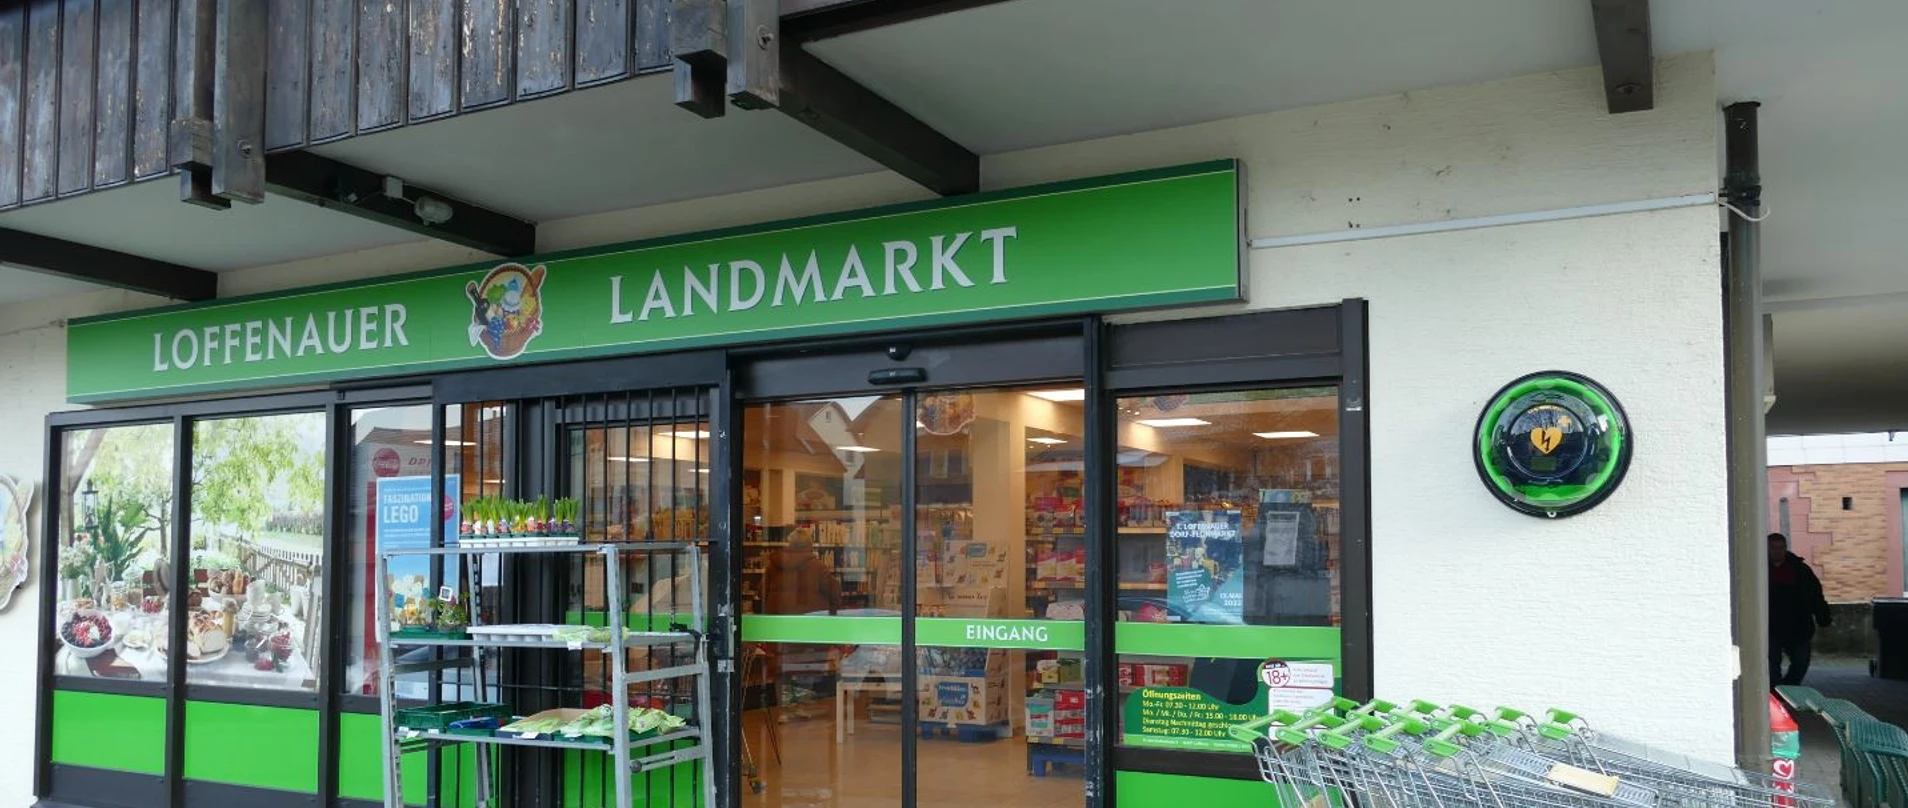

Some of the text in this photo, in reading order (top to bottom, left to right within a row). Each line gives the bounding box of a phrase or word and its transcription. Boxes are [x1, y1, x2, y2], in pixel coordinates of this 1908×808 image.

[153, 225, 1018, 372] LOFFENAUER LANDMARKT
[383, 505, 418, 523] LEGO
[966, 624, 1048, 642] EINGANG
[1266, 670, 1288, 685] 18+
[1142, 688, 1201, 701] Öffnungszeiten
